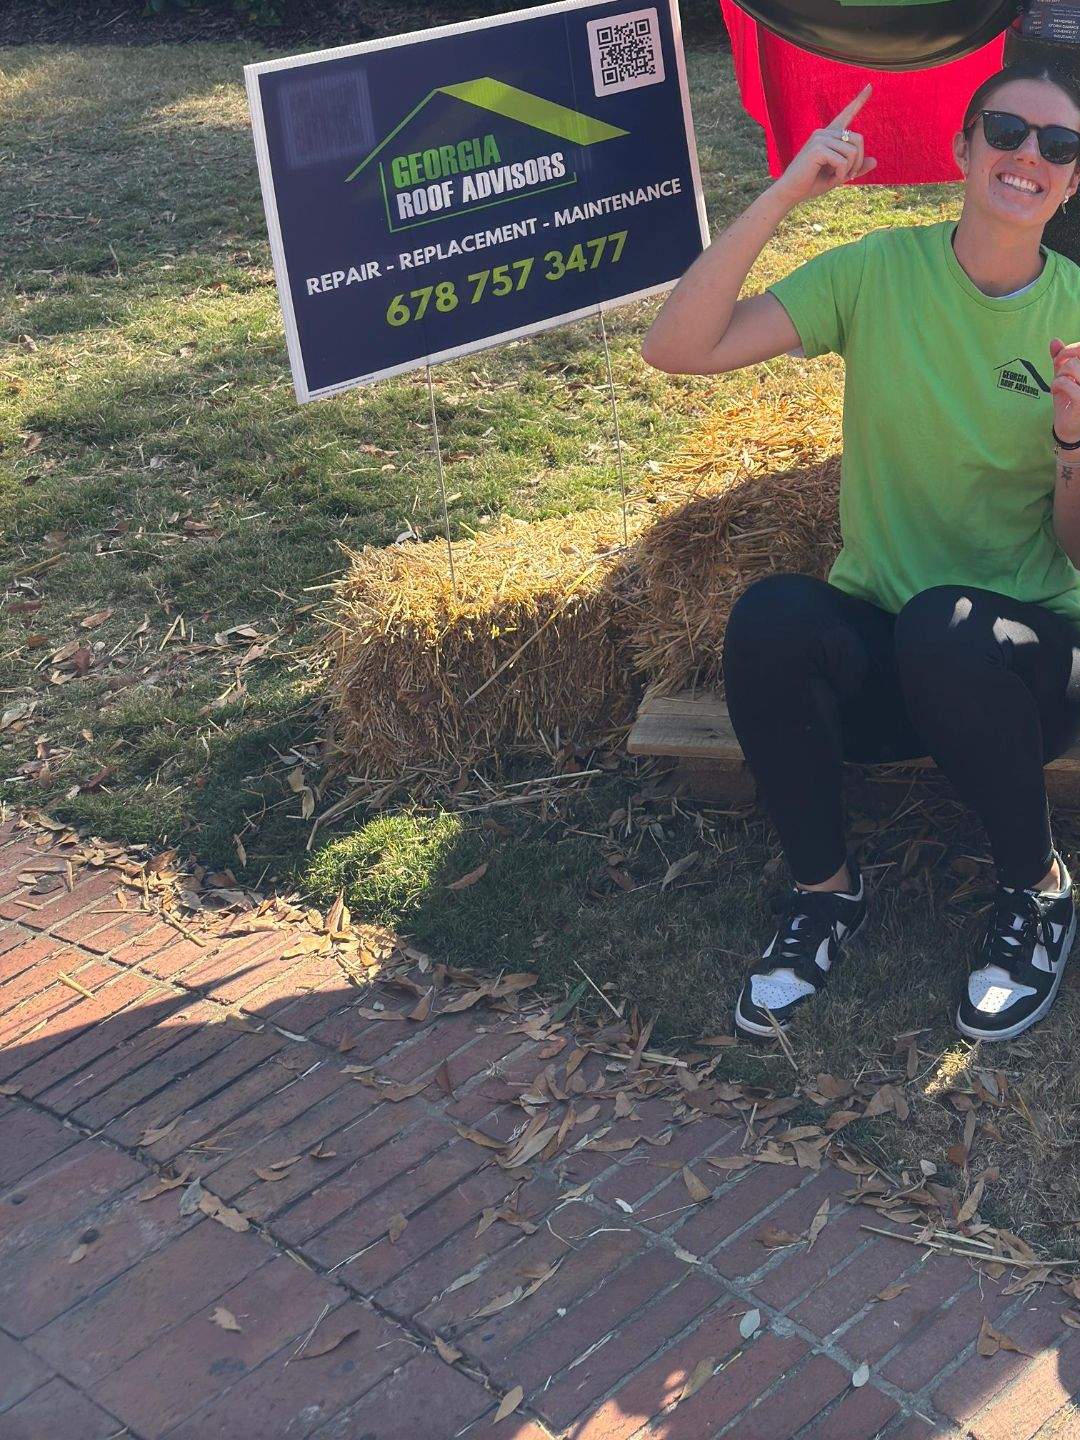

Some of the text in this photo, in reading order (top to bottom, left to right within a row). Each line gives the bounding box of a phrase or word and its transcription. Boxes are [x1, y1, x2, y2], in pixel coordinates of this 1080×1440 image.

[391, 134, 500, 189] GEORGIA
[397, 152, 566, 220] ROOF ADVISORS
[305, 260, 381, 295] REPAIR
[399, 218, 537, 271] REPLACEMENT
[554, 178, 681, 227] MAINTENANCE
[386, 231, 628, 327] 678 757 3477
[1002, 370, 1028, 384] GEORGIA
